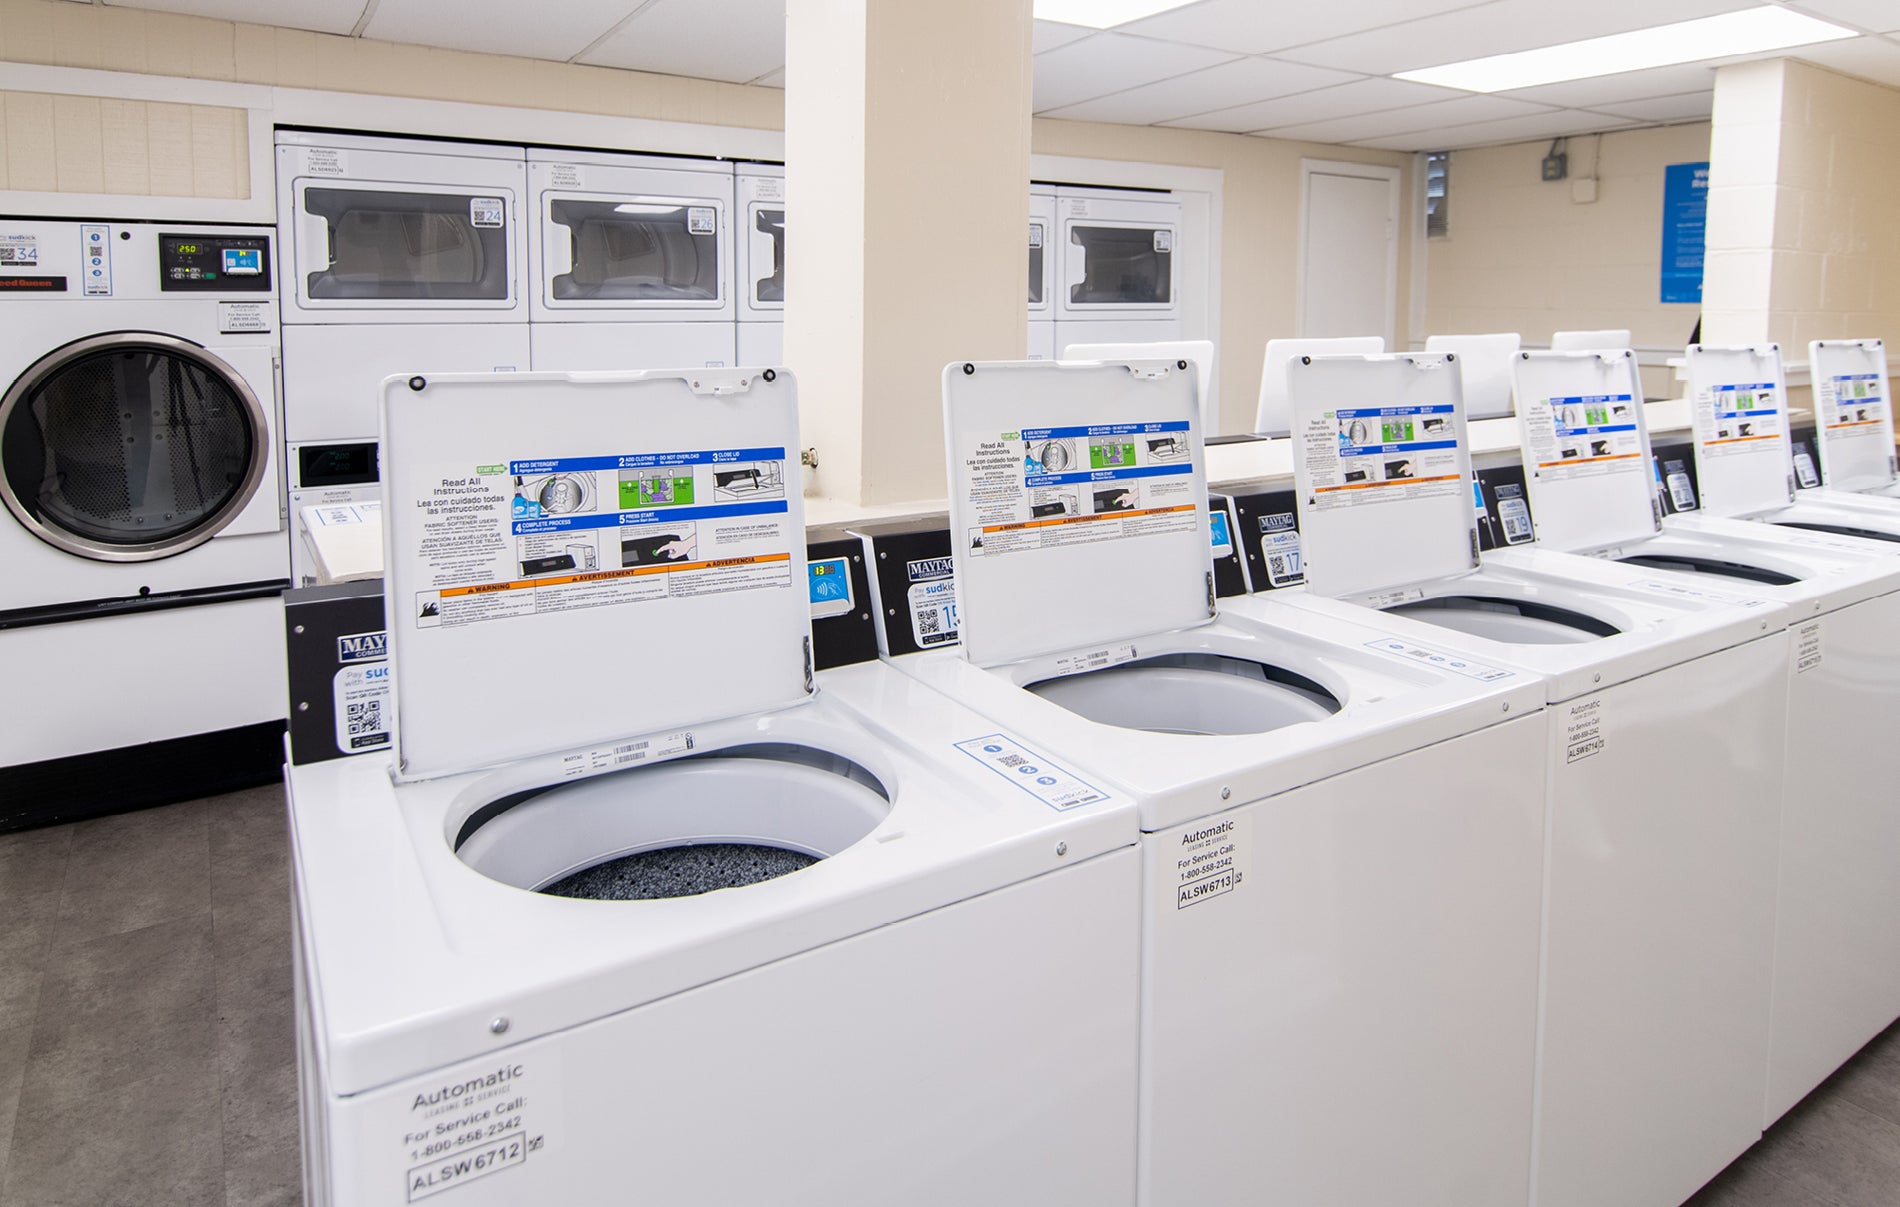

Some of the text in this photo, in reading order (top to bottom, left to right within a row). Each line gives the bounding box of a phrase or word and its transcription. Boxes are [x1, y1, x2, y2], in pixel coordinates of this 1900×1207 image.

[486, 211, 501, 221] 24
[701, 219, 713, 229] 26
[17, 247, 38, 260] 34
[179, 245, 196, 253] 250
[19, 279, 52, 287] Queen
[514, 463, 518, 473] 1
[619, 457, 625, 467] 2
[712, 453, 718, 462] 3
[442, 478, 480, 487] Read All
[434, 486, 489, 496] Instructions
[417, 500, 432, 508] Lea
[450, 497, 482, 505] cuidado
[483, 495, 504, 503] todas
[441, 504, 495, 514] instrucciones.
[515, 523, 522, 533] 4
[619, 514, 625, 524] 5
[1261, 515, 1292, 527] MAYTAG
[1516, 516, 1529, 532] 19
[713, 557, 756, 568] ADVERTENCIA
[1286, 552, 1299, 572] 17
[579, 570, 635, 581] AVERTISSEMENT
[918, 570, 950, 578] COMMERCIAL
[475, 583, 510, 593] WARNING
[346, 671, 363, 680] Pay
[1570, 700, 1600, 716] Automatic
[1569, 741, 1598, 757] ALSW6714
[1182, 821, 1234, 846] Automatic
[1178, 844, 1236, 869] For Service Call:
[1180, 856, 1232, 880] 1-800-558-2342
[1180, 876, 1231, 902] ALSW6713
[412, 1064, 524, 1112] Automatic
[404, 1097, 528, 1145] For Service Call:
[411, 1116, 522, 1160] 1-800-558-2342
[413, 1142, 520, 1192] ALSW6712
